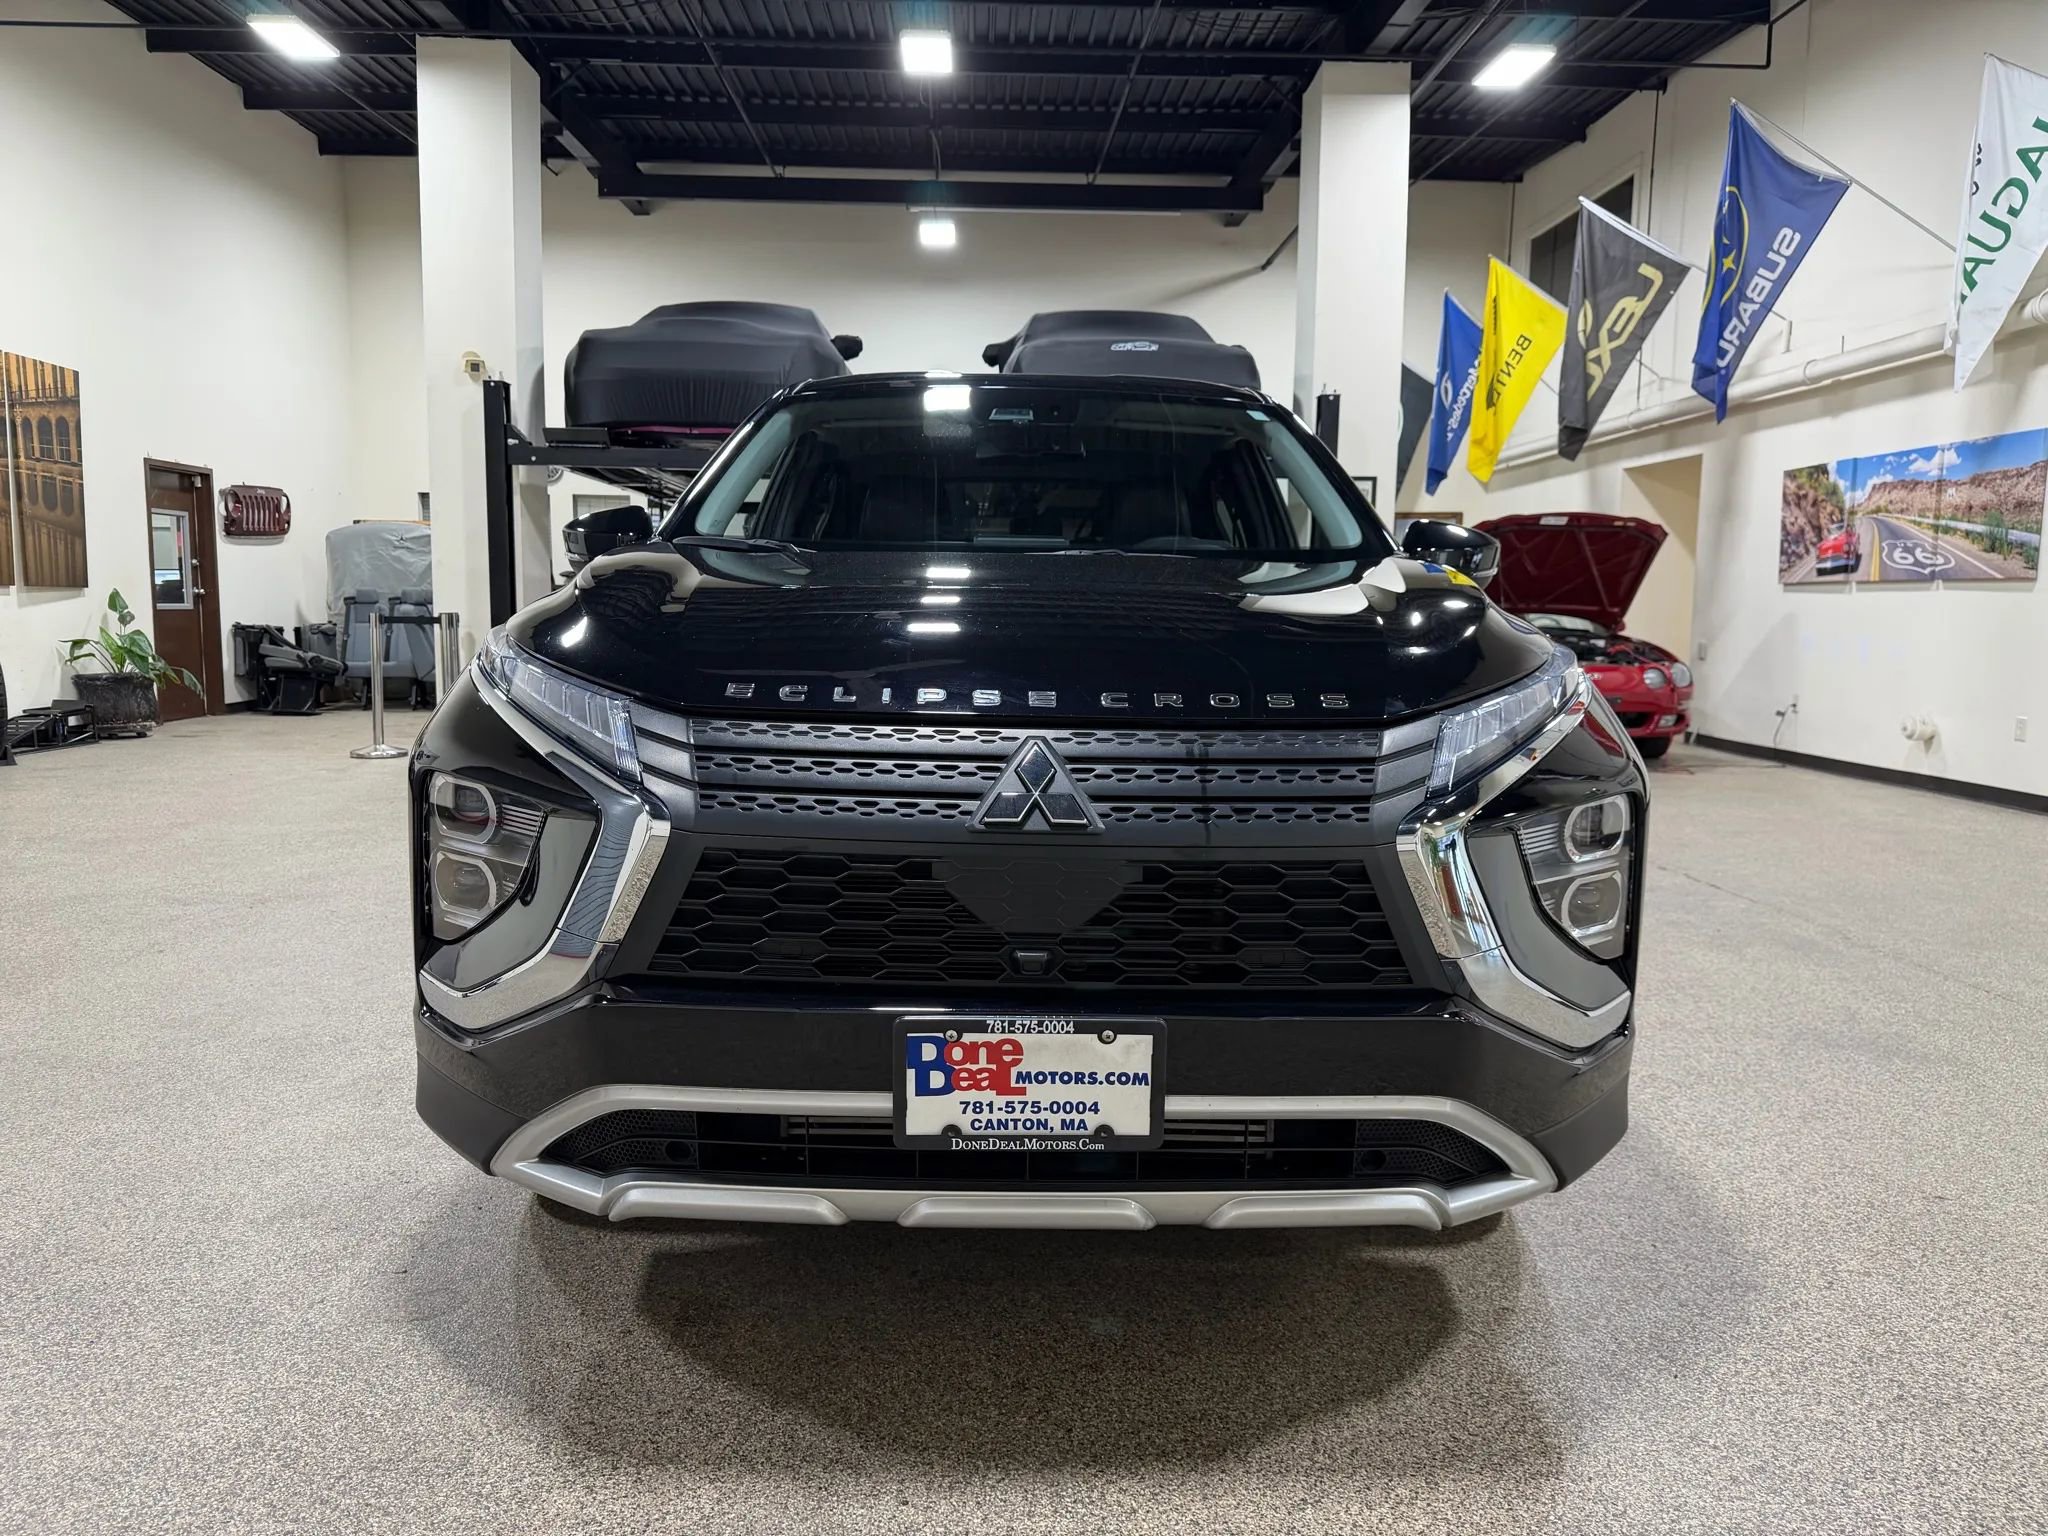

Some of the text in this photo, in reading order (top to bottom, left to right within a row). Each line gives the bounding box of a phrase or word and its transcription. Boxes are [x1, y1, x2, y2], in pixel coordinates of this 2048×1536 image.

[1893, 547, 1945, 565] 66
[724, 682, 1350, 709] ECLIPSE CROSS
[986, 1020, 1075, 1034] 781-575-0004
[907, 1035, 1024, 1069] Done
[1015, 1071, 1150, 1087] MOTORS.COM
[959, 1101, 1101, 1115] 781-575-0004
[970, 1118, 1089, 1133] CANTON, MA
